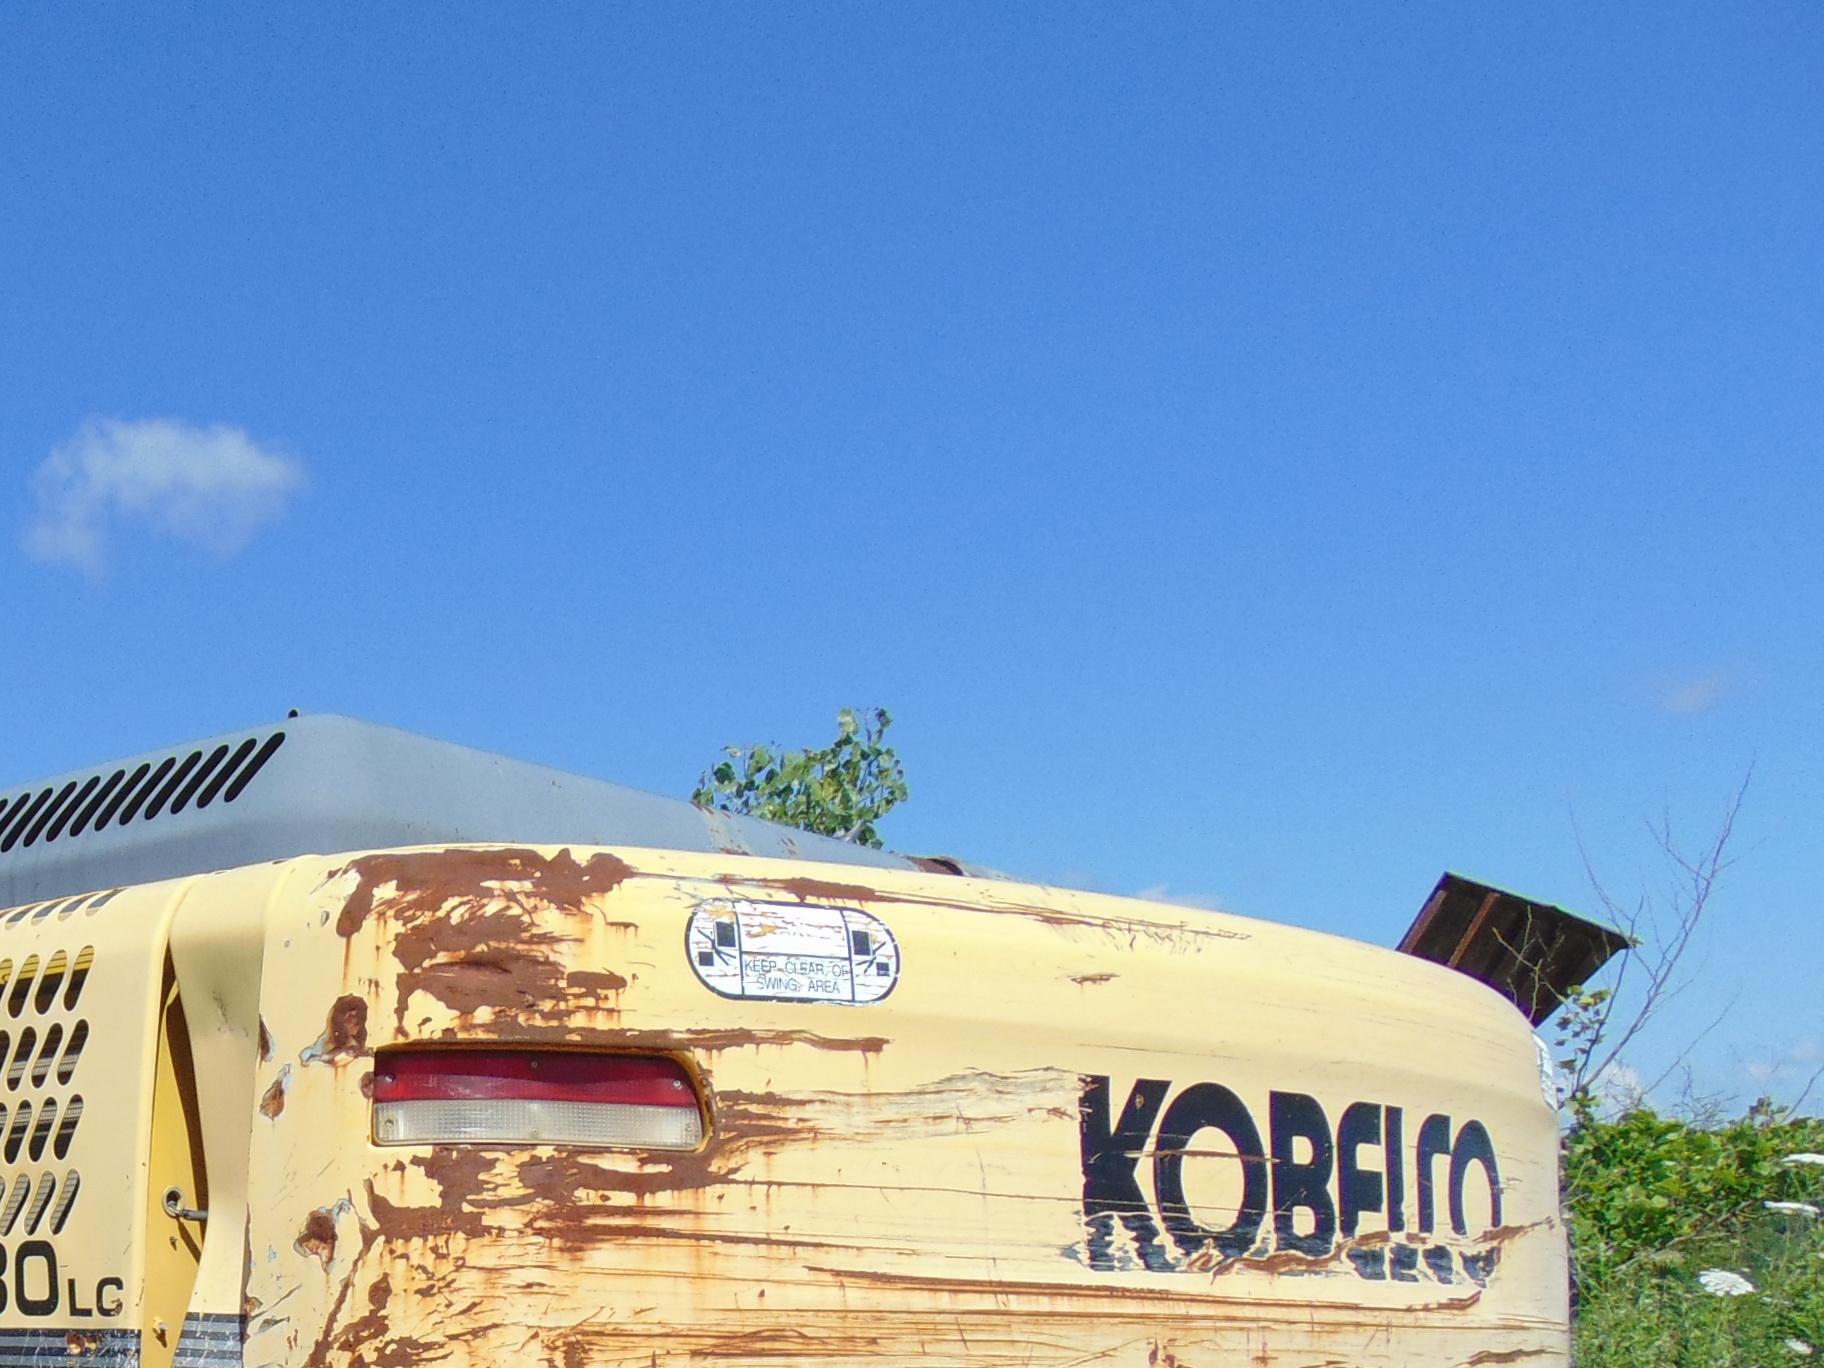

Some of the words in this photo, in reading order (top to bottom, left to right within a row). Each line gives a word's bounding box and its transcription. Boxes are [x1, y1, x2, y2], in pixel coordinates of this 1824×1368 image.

[744, 959, 777, 973] KEEP
[784, 960, 825, 976] CLEAR
[756, 976, 798, 992] SWING
[807, 979, 841, 994] AREA
[1078, 1073, 1503, 1286] KOBELCO
